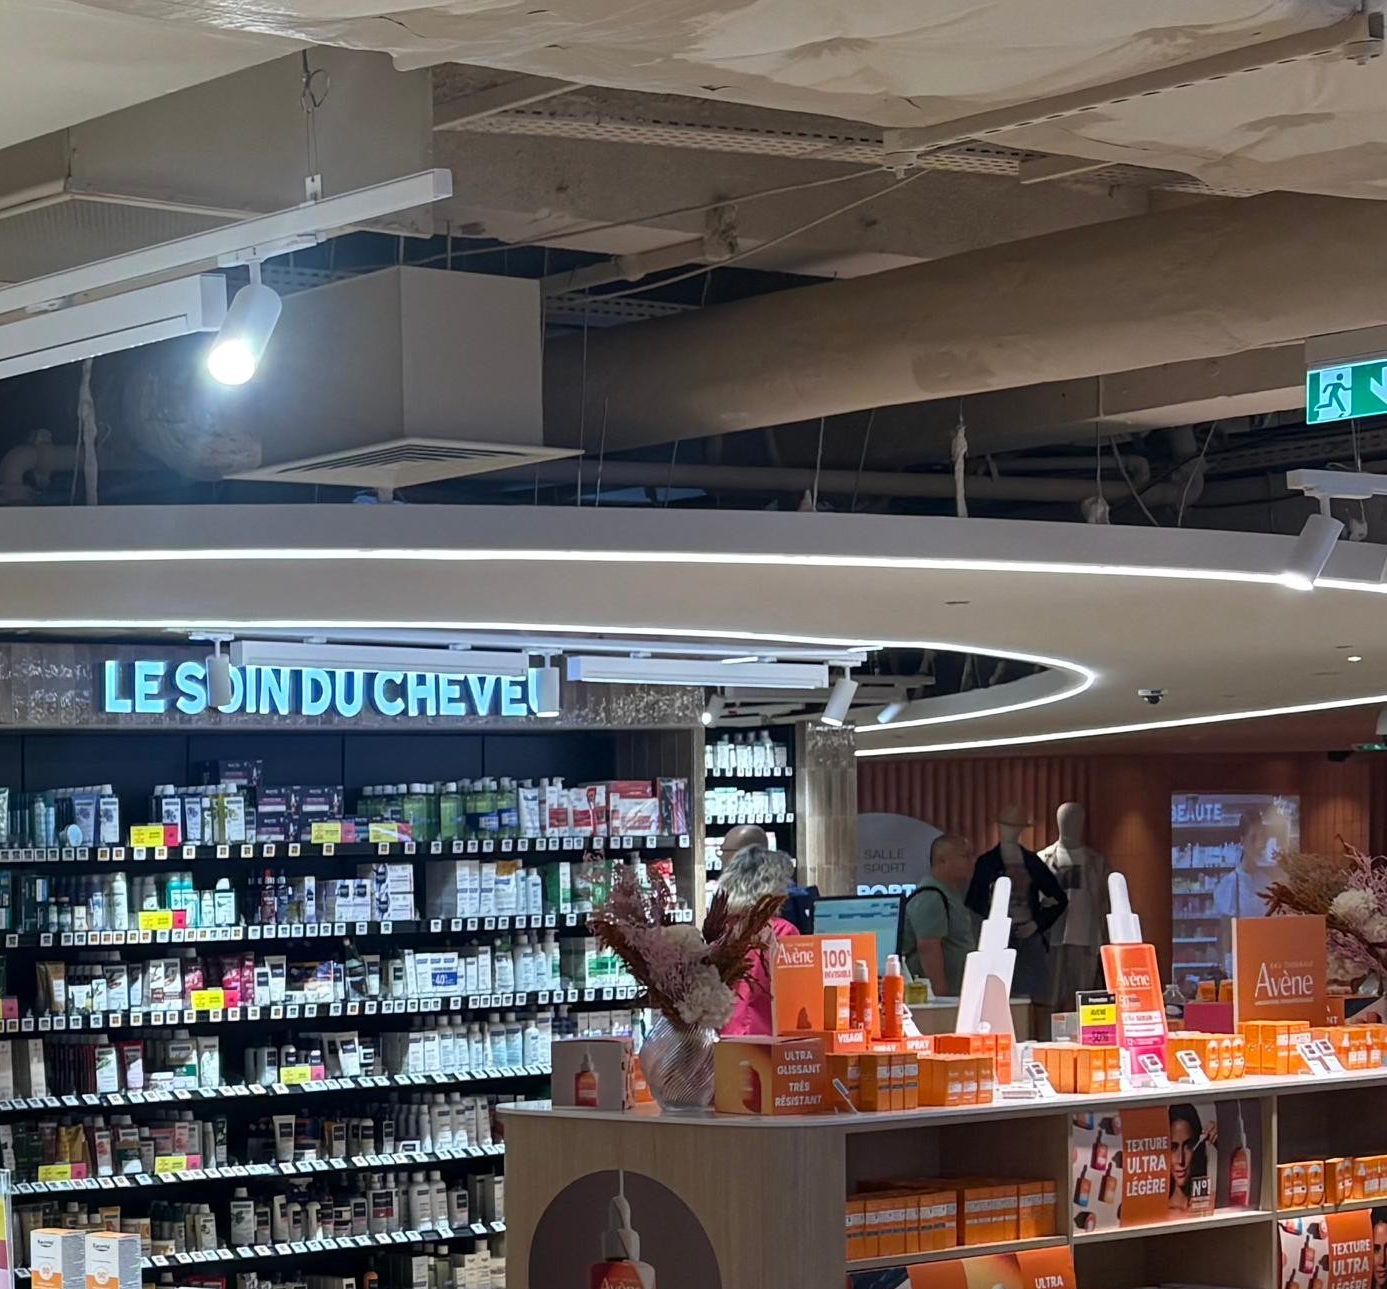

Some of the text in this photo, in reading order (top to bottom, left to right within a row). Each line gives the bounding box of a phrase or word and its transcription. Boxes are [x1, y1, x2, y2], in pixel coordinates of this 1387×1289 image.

[105, 660, 165, 714] LE
[175, 660, 291, 716] SOIN
[301, 667, 364, 718] DU
[863, 848, 905, 861] SALLE
[863, 862, 907, 875] SPORT
[776, 943, 815, 964] Avène
[1254, 962, 1314, 998] Avène
[784, 1050, 813, 1061] ULTRA
[1125, 1136, 1168, 1153] TEXTURE
[1126, 1153, 1167, 1175] ULTRA
[1126, 1175, 1166, 1197] LÉGÈRE
[1331, 1239, 1371, 1256] TEXTURE
[1332, 1256, 1370, 1276] ULTRA
[1034, 1275, 1064, 1289] ULTRA
